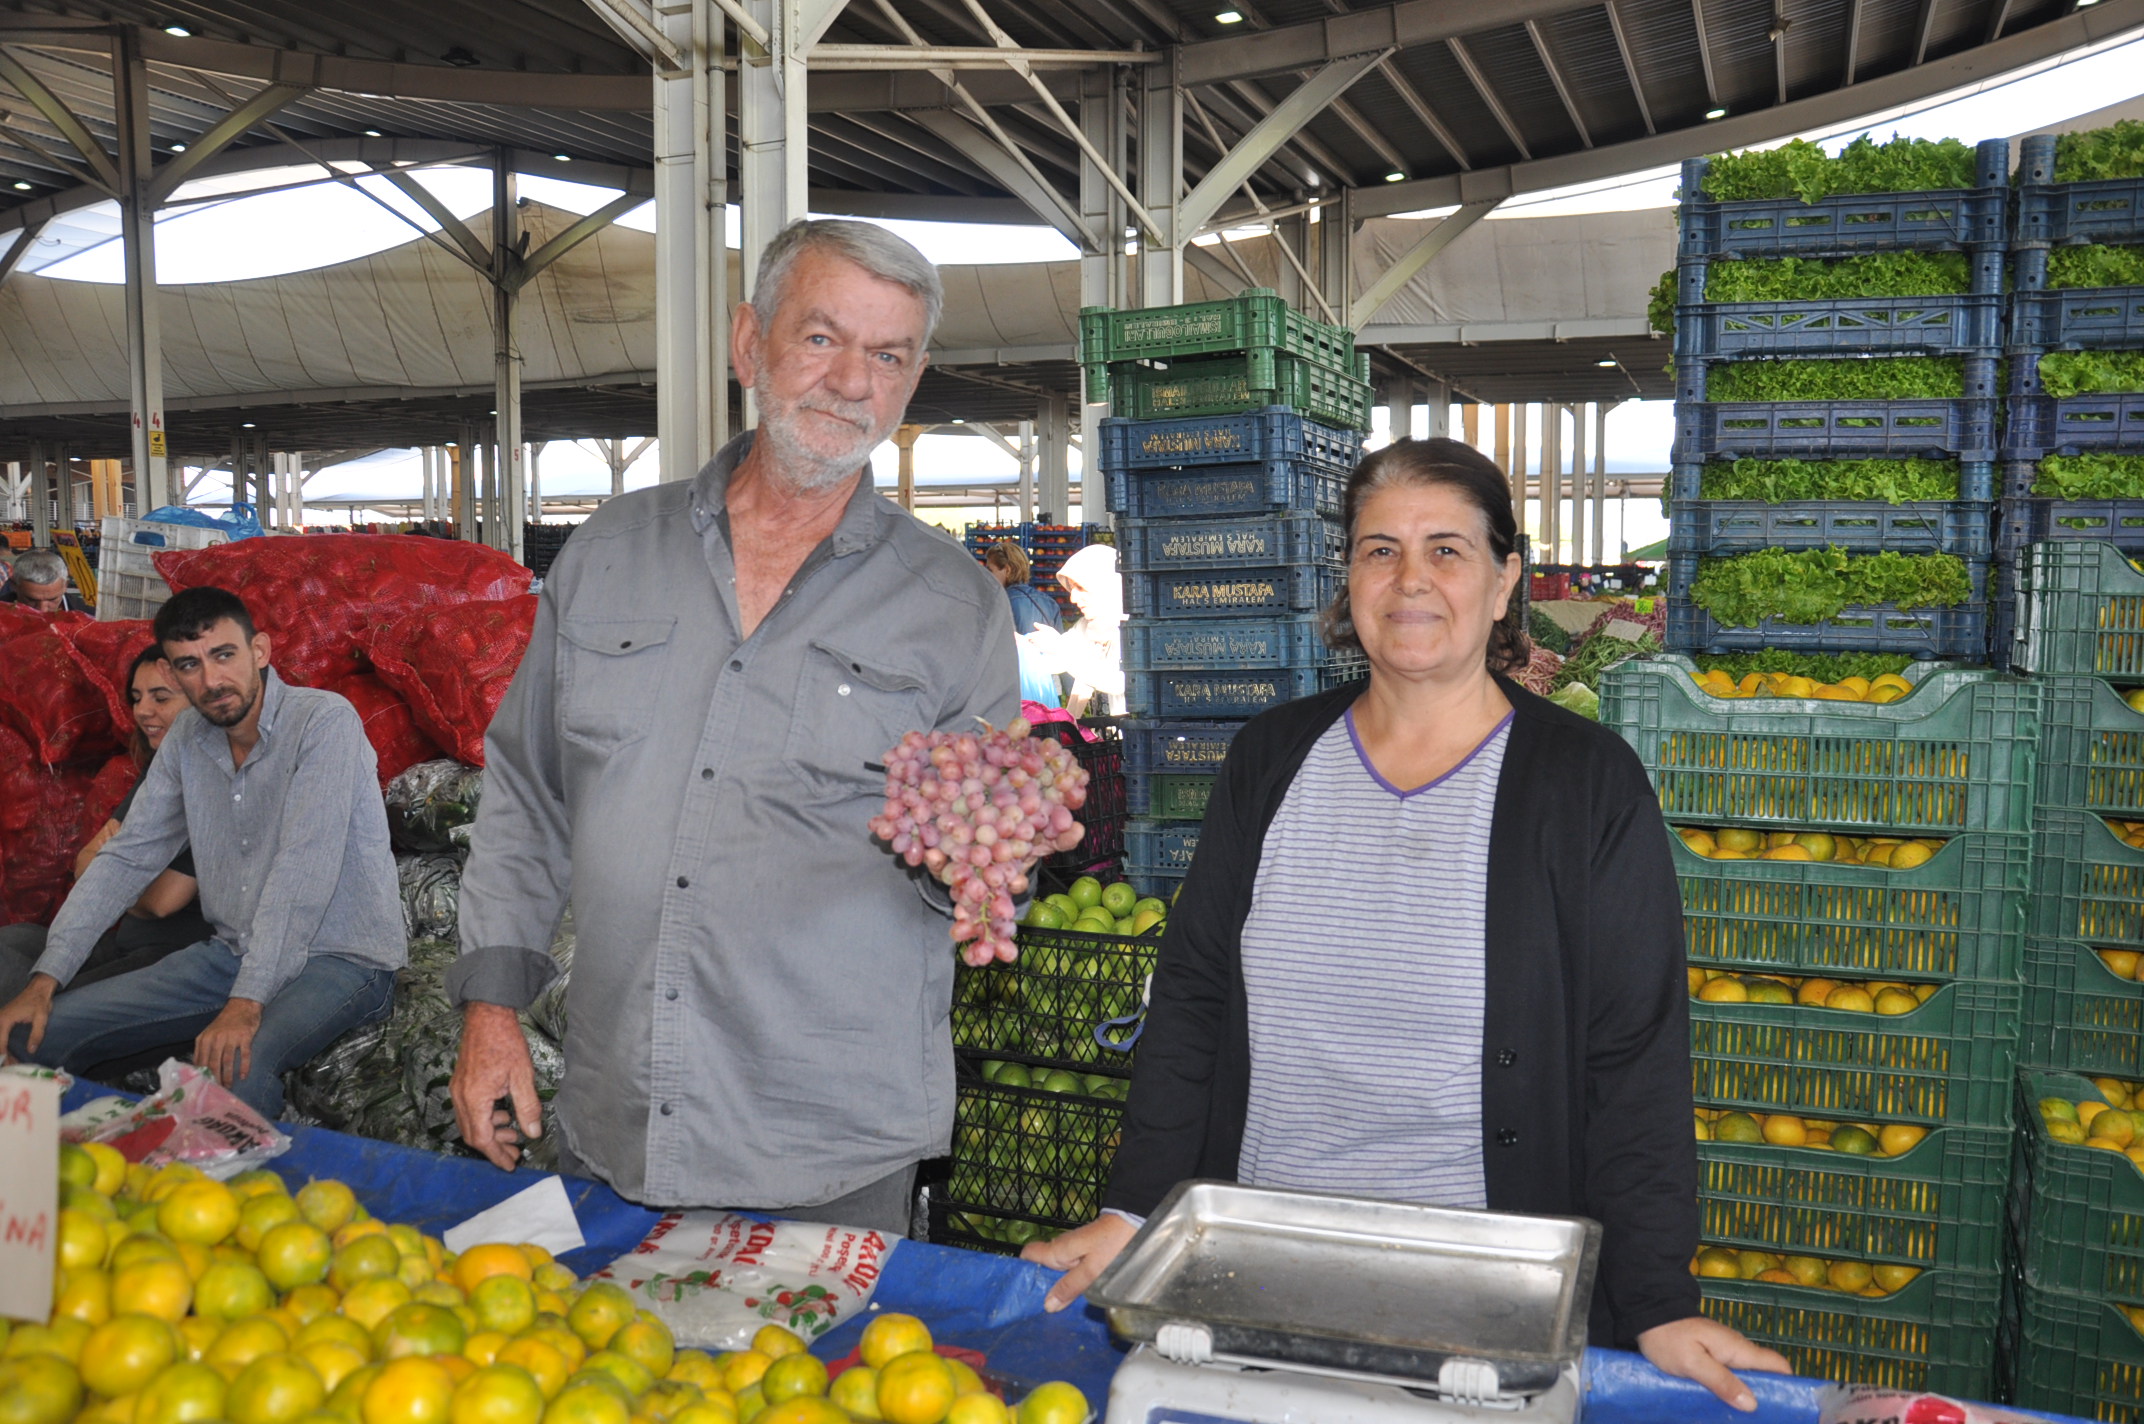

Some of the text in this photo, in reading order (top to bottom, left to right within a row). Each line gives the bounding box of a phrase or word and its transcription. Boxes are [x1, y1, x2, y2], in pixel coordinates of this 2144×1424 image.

[133, 412, 141, 428] 4
[152, 412, 161, 428] 4
[514, 448, 520, 462] 5
[1162, 539, 1265, 556] KARA MUSTAFA
[1173, 583, 1275, 600] KARA MUSTAFA
[1164, 642, 1226, 656] MUSTAFA
[1165, 750, 1227, 762] MUSTAFA
